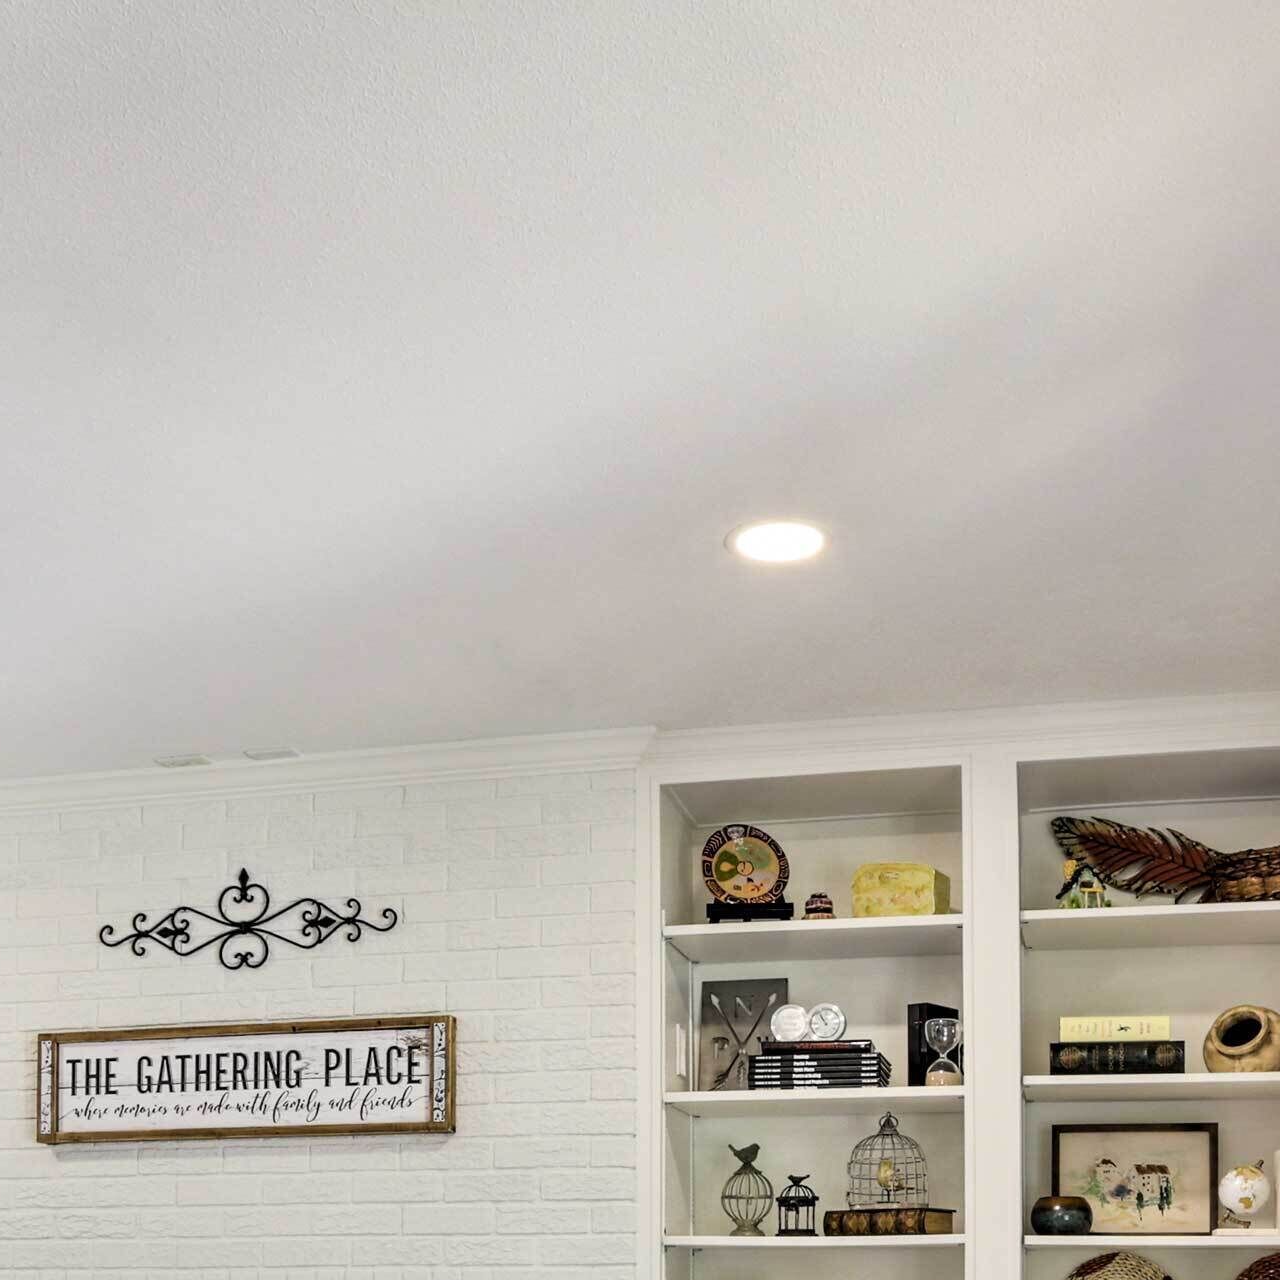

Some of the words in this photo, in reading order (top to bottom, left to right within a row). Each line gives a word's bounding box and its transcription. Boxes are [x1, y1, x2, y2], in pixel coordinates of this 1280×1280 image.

[66, 1057, 118, 1096] THE
[137, 1049, 302, 1094] GATHERING
[324, 1045, 421, 1087] PLACE
[72, 1097, 109, 1120] where
[113, 1101, 168, 1117] memories
[173, 1103, 192, 1115] are
[197, 1092, 231, 1114] made
[236, 1090, 268, 1115] with
[272, 1088, 321, 1123] family
[328, 1087, 356, 1113] and
[359, 1085, 414, 1121] friends
